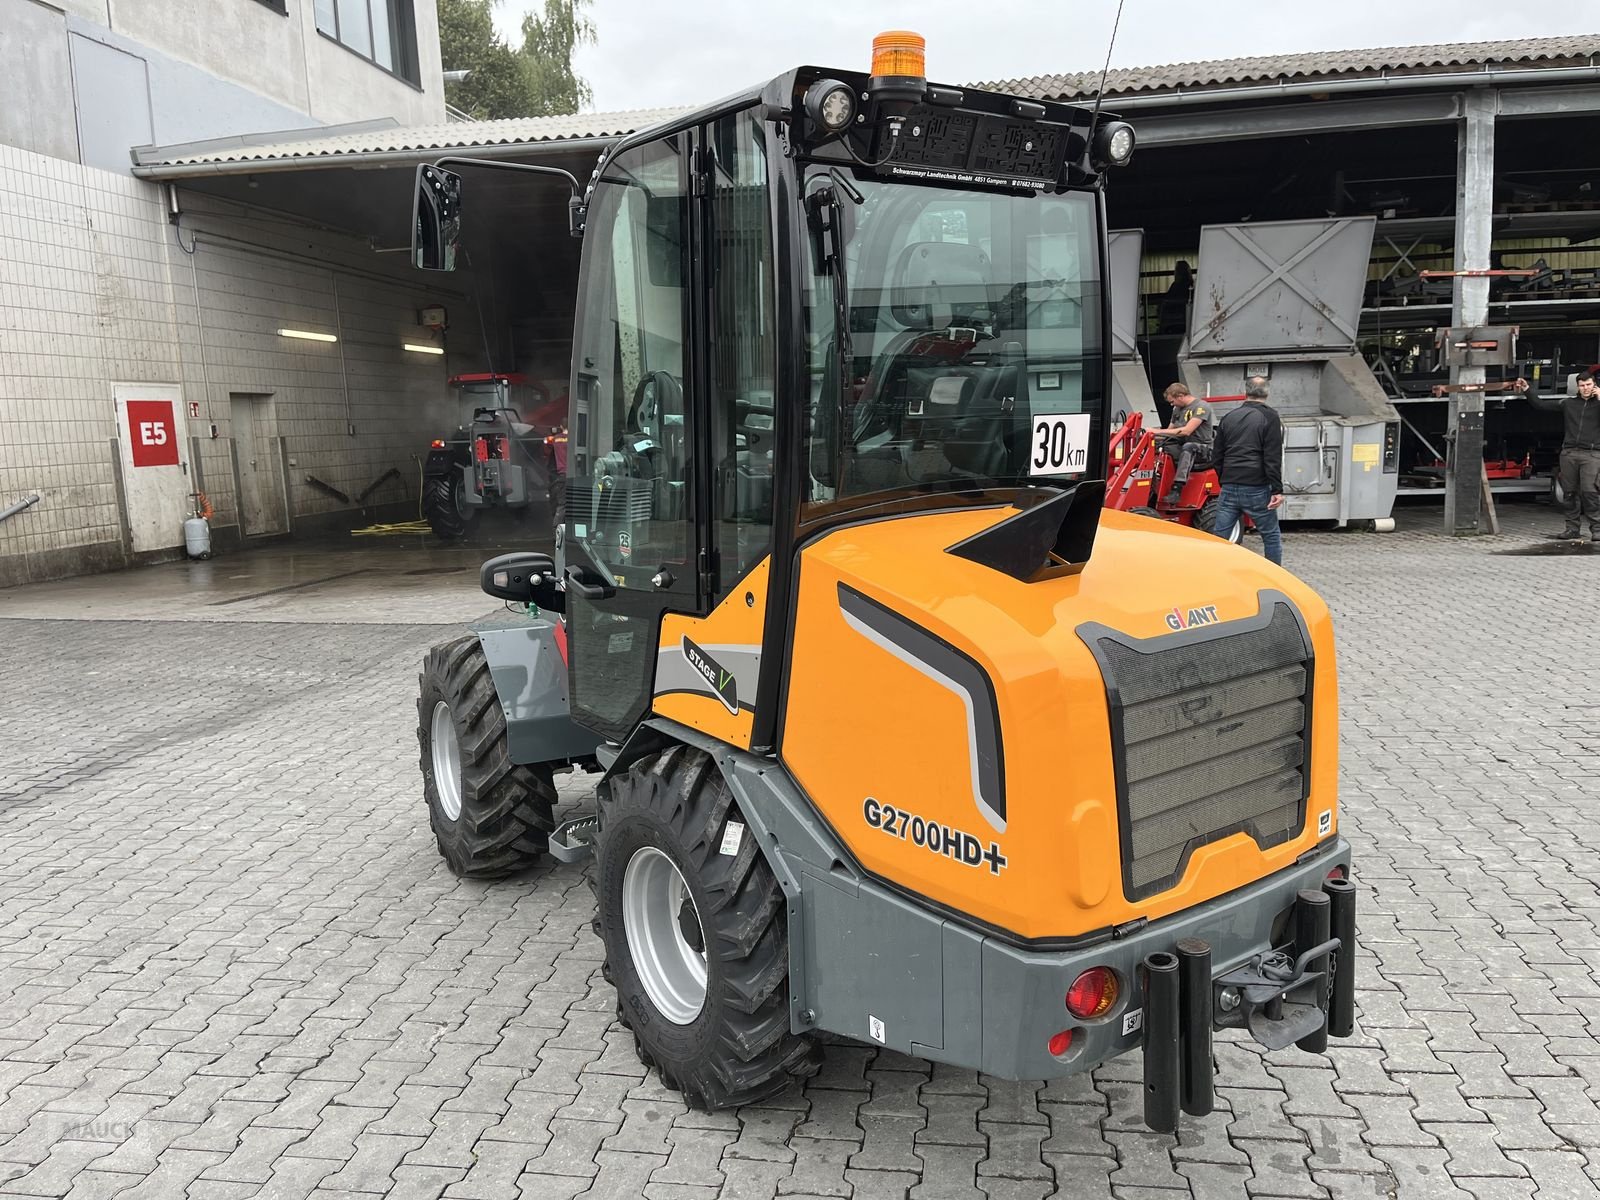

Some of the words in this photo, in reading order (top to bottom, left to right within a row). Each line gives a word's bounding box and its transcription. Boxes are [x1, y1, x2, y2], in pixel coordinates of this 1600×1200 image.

[892, 167, 926, 177] Schwarzmayr
[926, 170, 957, 181] Landtechnik
[957, 173, 973, 182] GmbH
[986, 177, 1008, 186] Gampern
[140, 421, 167, 446] E5
[1033, 420, 1067, 469] 30
[1066, 441, 1085, 467] km
[1165, 605, 1219, 631] GIANT
[688, 648, 716, 684] STAGE
[863, 797, 1007, 876] G2700HD+
